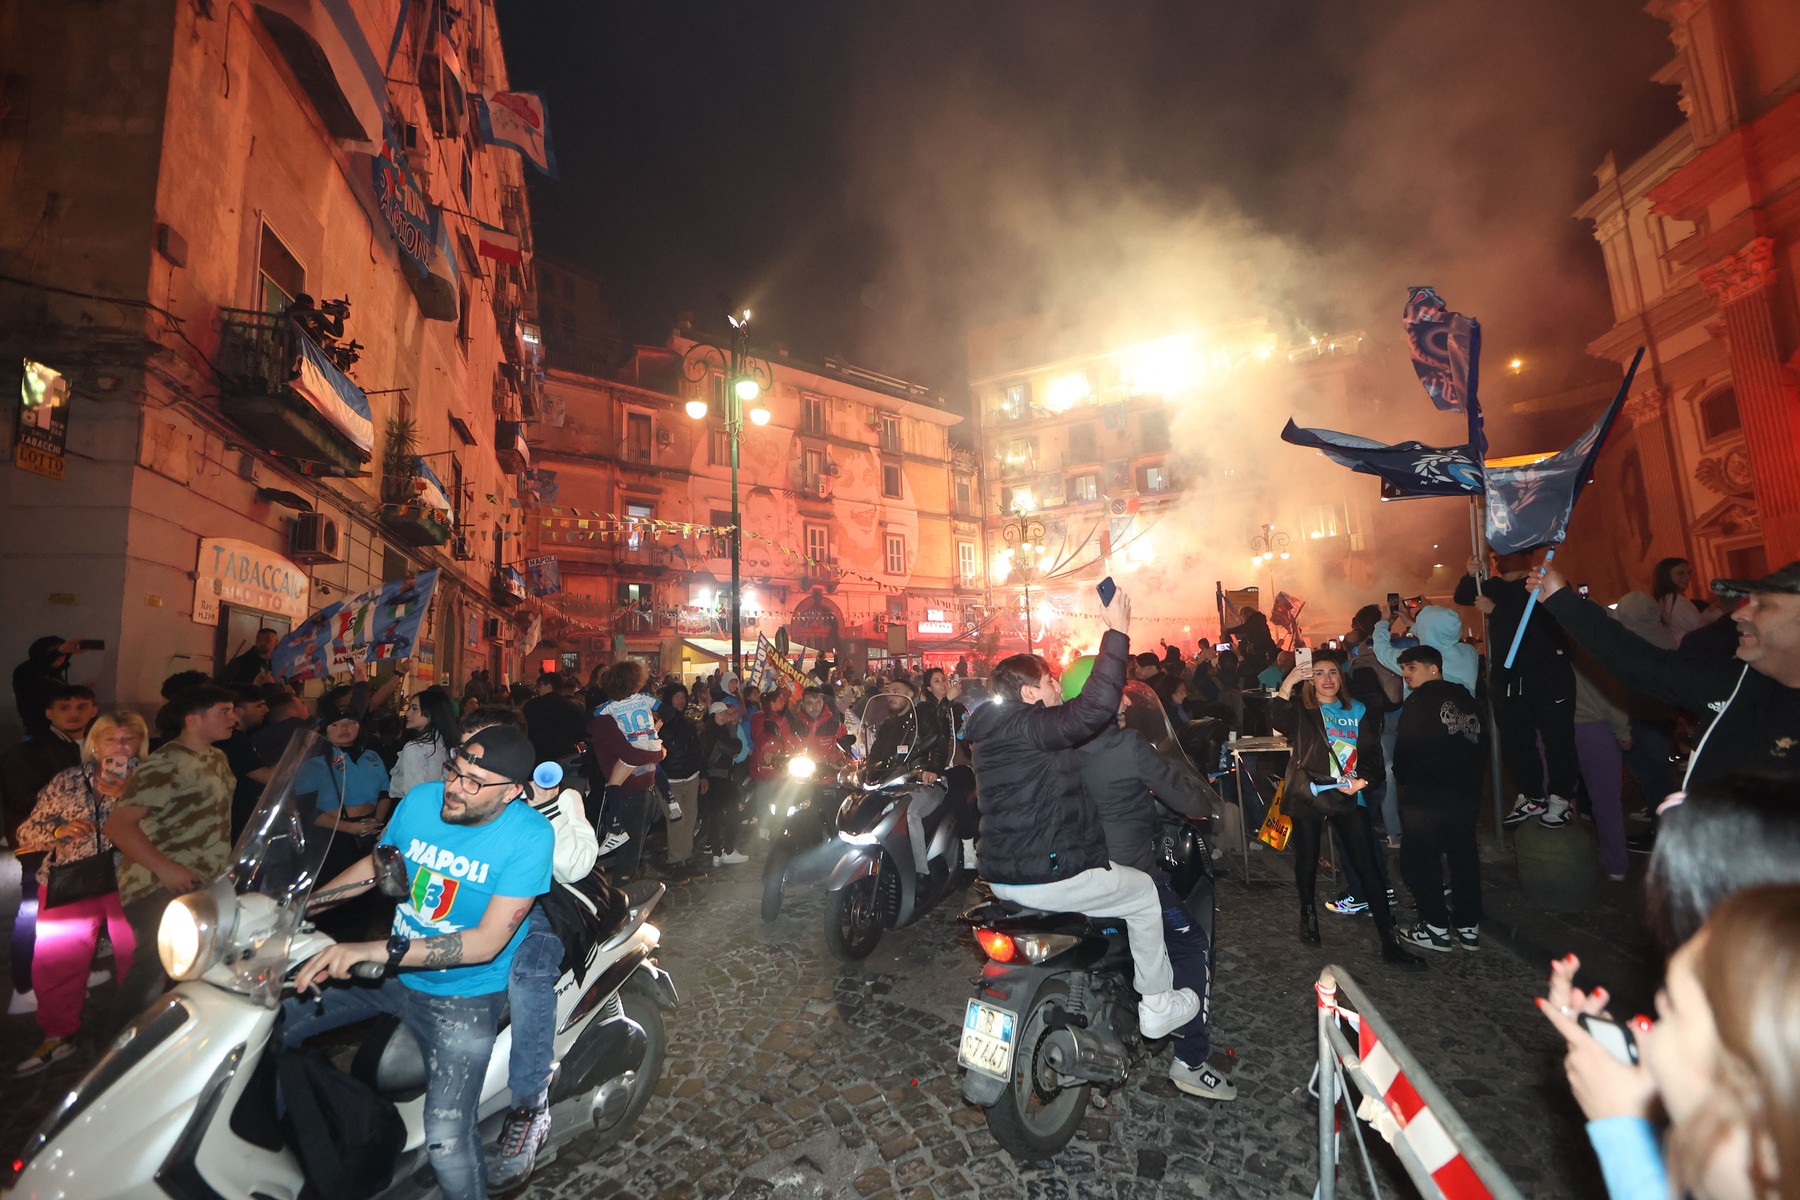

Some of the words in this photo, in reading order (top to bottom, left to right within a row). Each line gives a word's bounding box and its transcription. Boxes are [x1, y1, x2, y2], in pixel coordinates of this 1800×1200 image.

[21, 434, 61, 455] TABACCHI
[20, 448, 63, 472] LOTTO
[529, 555, 557, 567] NAPOLI
[617, 709, 650, 733] 10
[404, 838, 490, 884] NAPOLI
[424, 883, 445, 909] 3
